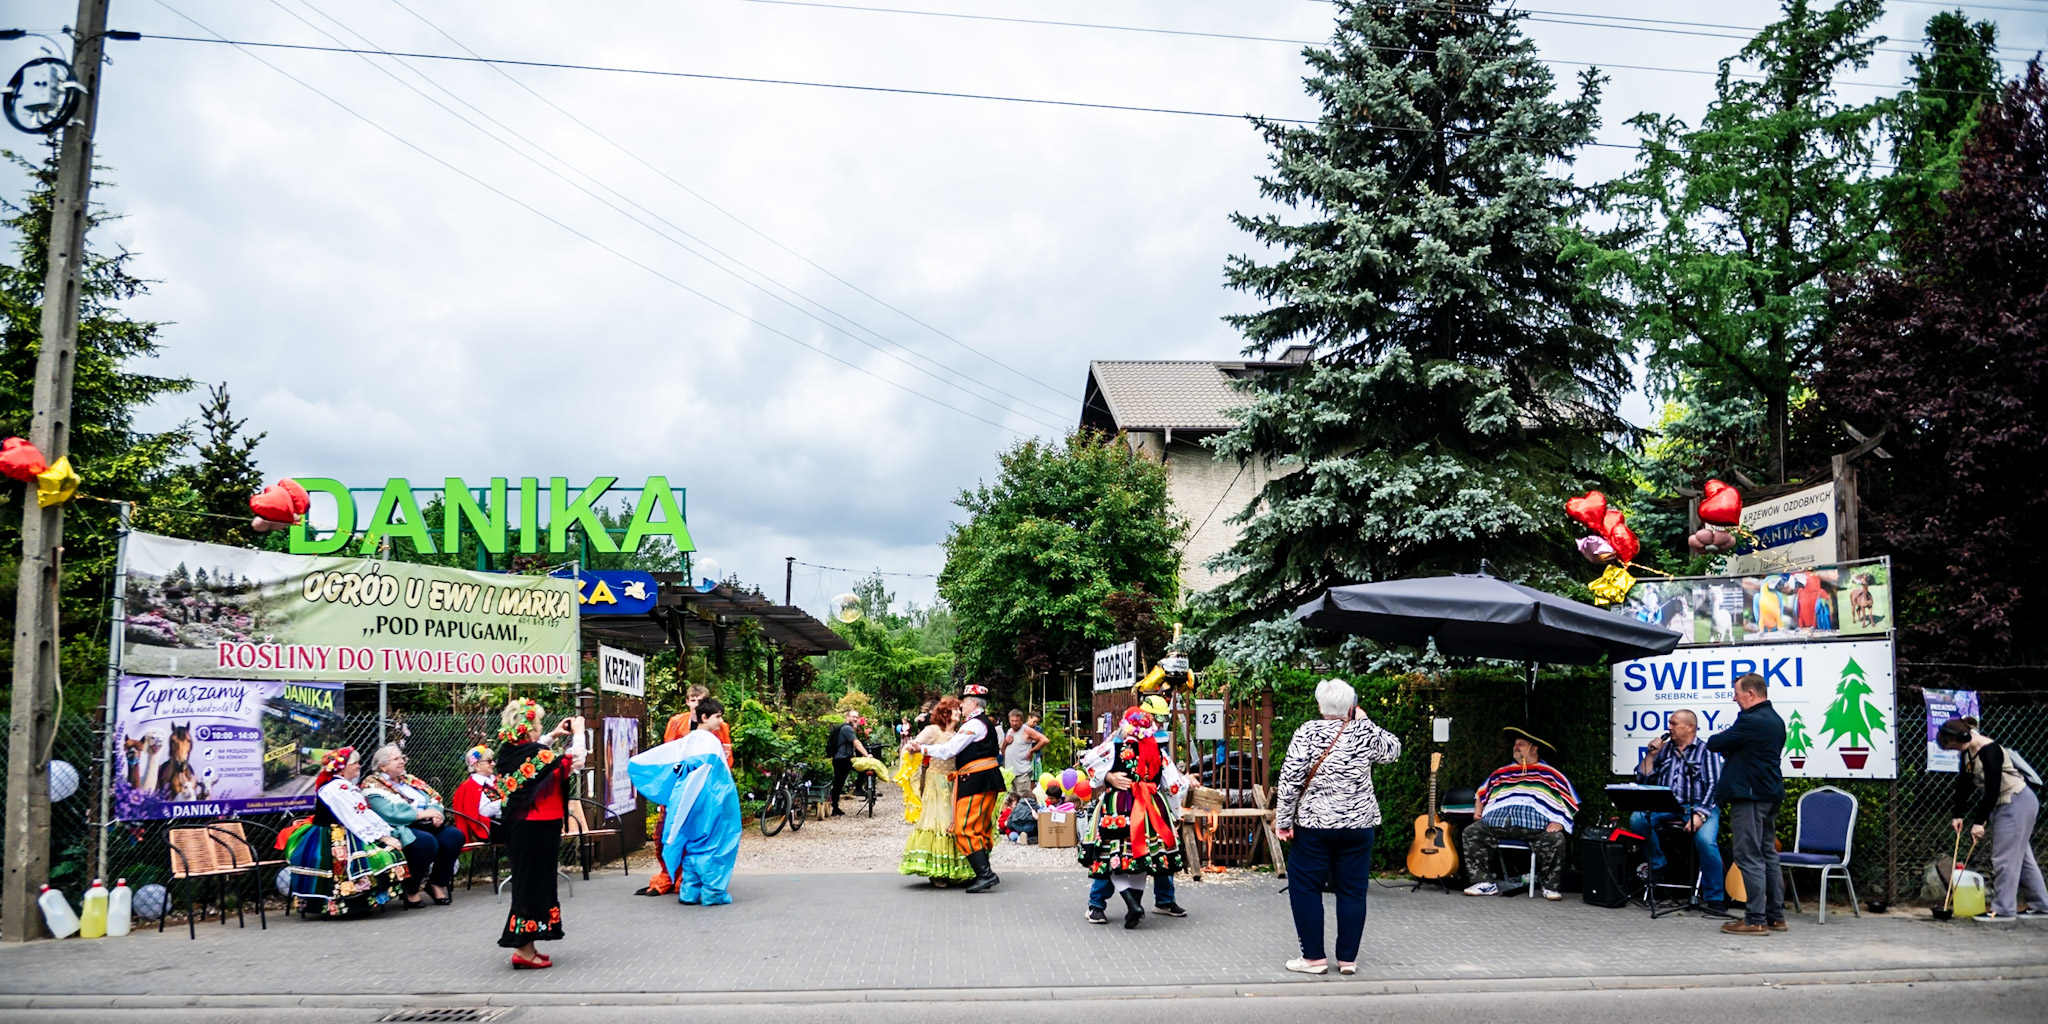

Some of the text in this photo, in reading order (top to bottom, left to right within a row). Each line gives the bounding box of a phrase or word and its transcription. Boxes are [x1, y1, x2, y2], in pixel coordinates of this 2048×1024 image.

[289, 476, 697, 555] DANIKA
[1743, 491, 1831, 523] KRZEWÓW OZDOBNYCH
[303, 563, 399, 608] OGRÓD
[405, 577, 425, 609] U
[428, 579, 482, 613] EWY
[482, 585, 496, 615] I
[497, 586, 570, 620] MARKA
[219, 635, 570, 675] ROŚLINY DO TWOJEGO OGRODU
[1096, 650, 1133, 684] OZDOBNE
[605, 654, 641, 690] KRZEWY
[130, 680, 250, 715] Zapraszamy
[284, 684, 334, 712] DANIKA
[1655, 692, 1699, 701] SREBRNE
[1715, 691, 1734, 699] SER
[212, 731, 234, 739] 10:00
[238, 731, 259, 739] 14:00
[1202, 713, 1217, 725] 23
[1624, 710, 1720, 731] JOY
[173, 804, 221, 817] DANIKA
